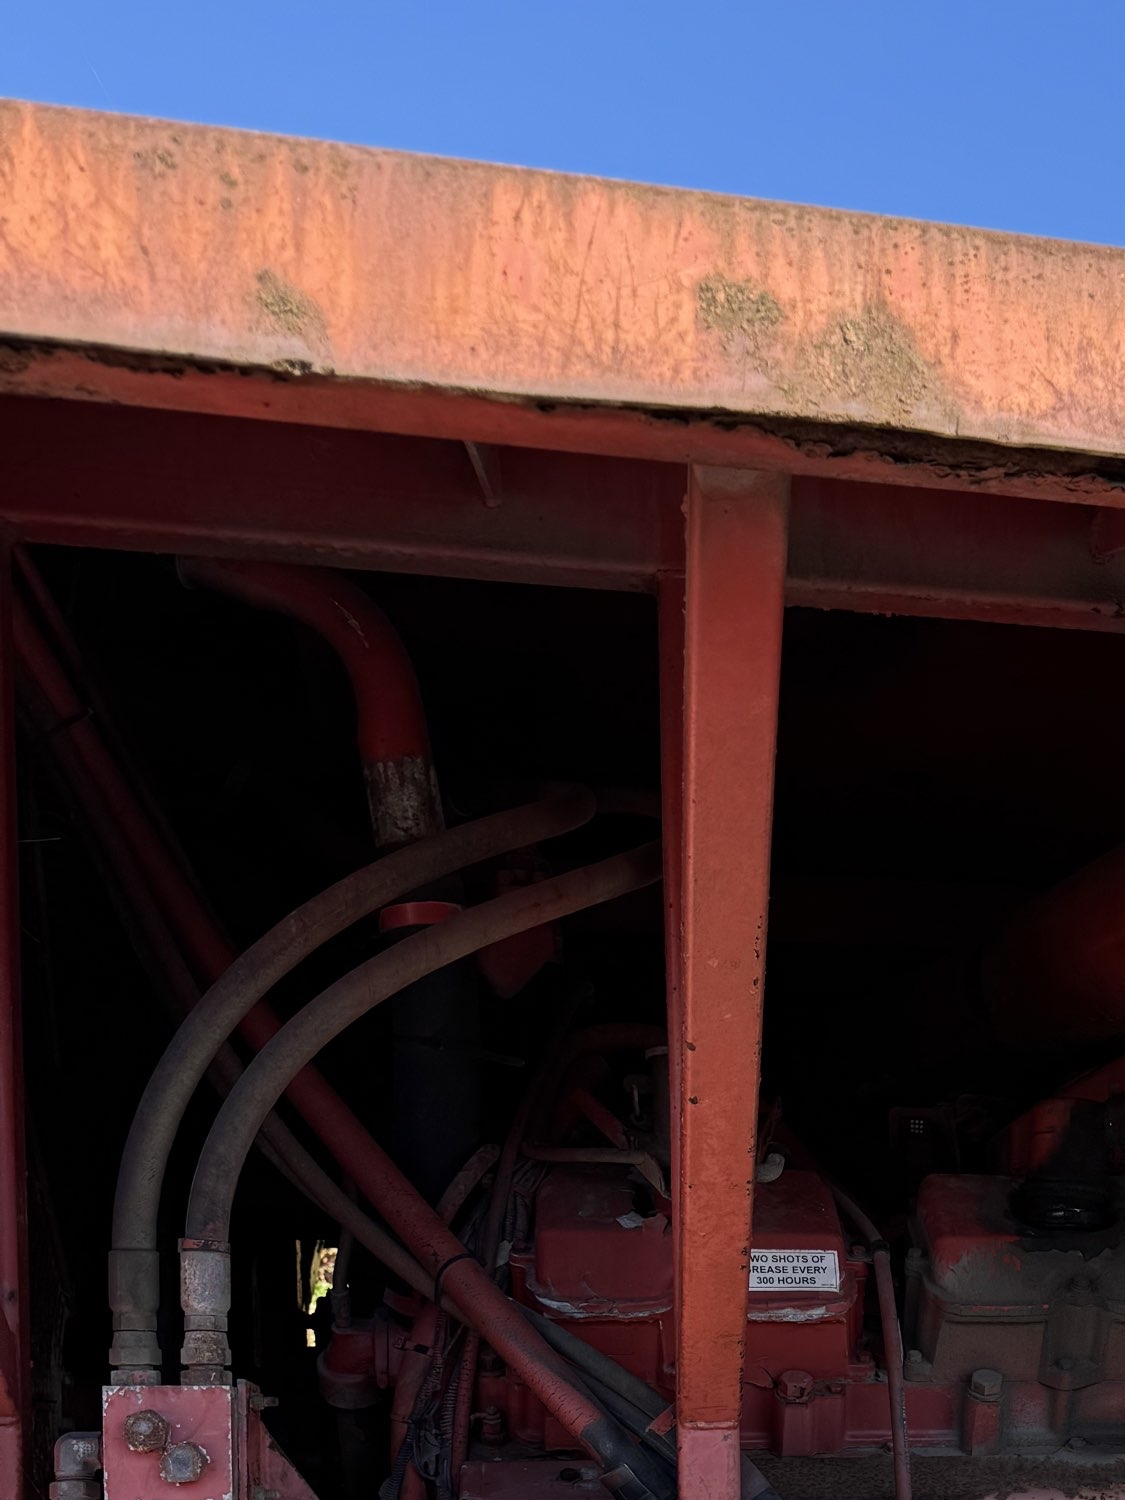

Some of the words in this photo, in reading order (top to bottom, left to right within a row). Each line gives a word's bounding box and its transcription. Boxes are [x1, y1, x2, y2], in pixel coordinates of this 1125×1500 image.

[772, 1255, 808, 1263] SHOTS
[792, 1266, 827, 1274] EVERY
[778, 1277, 816, 1285] HOURS
